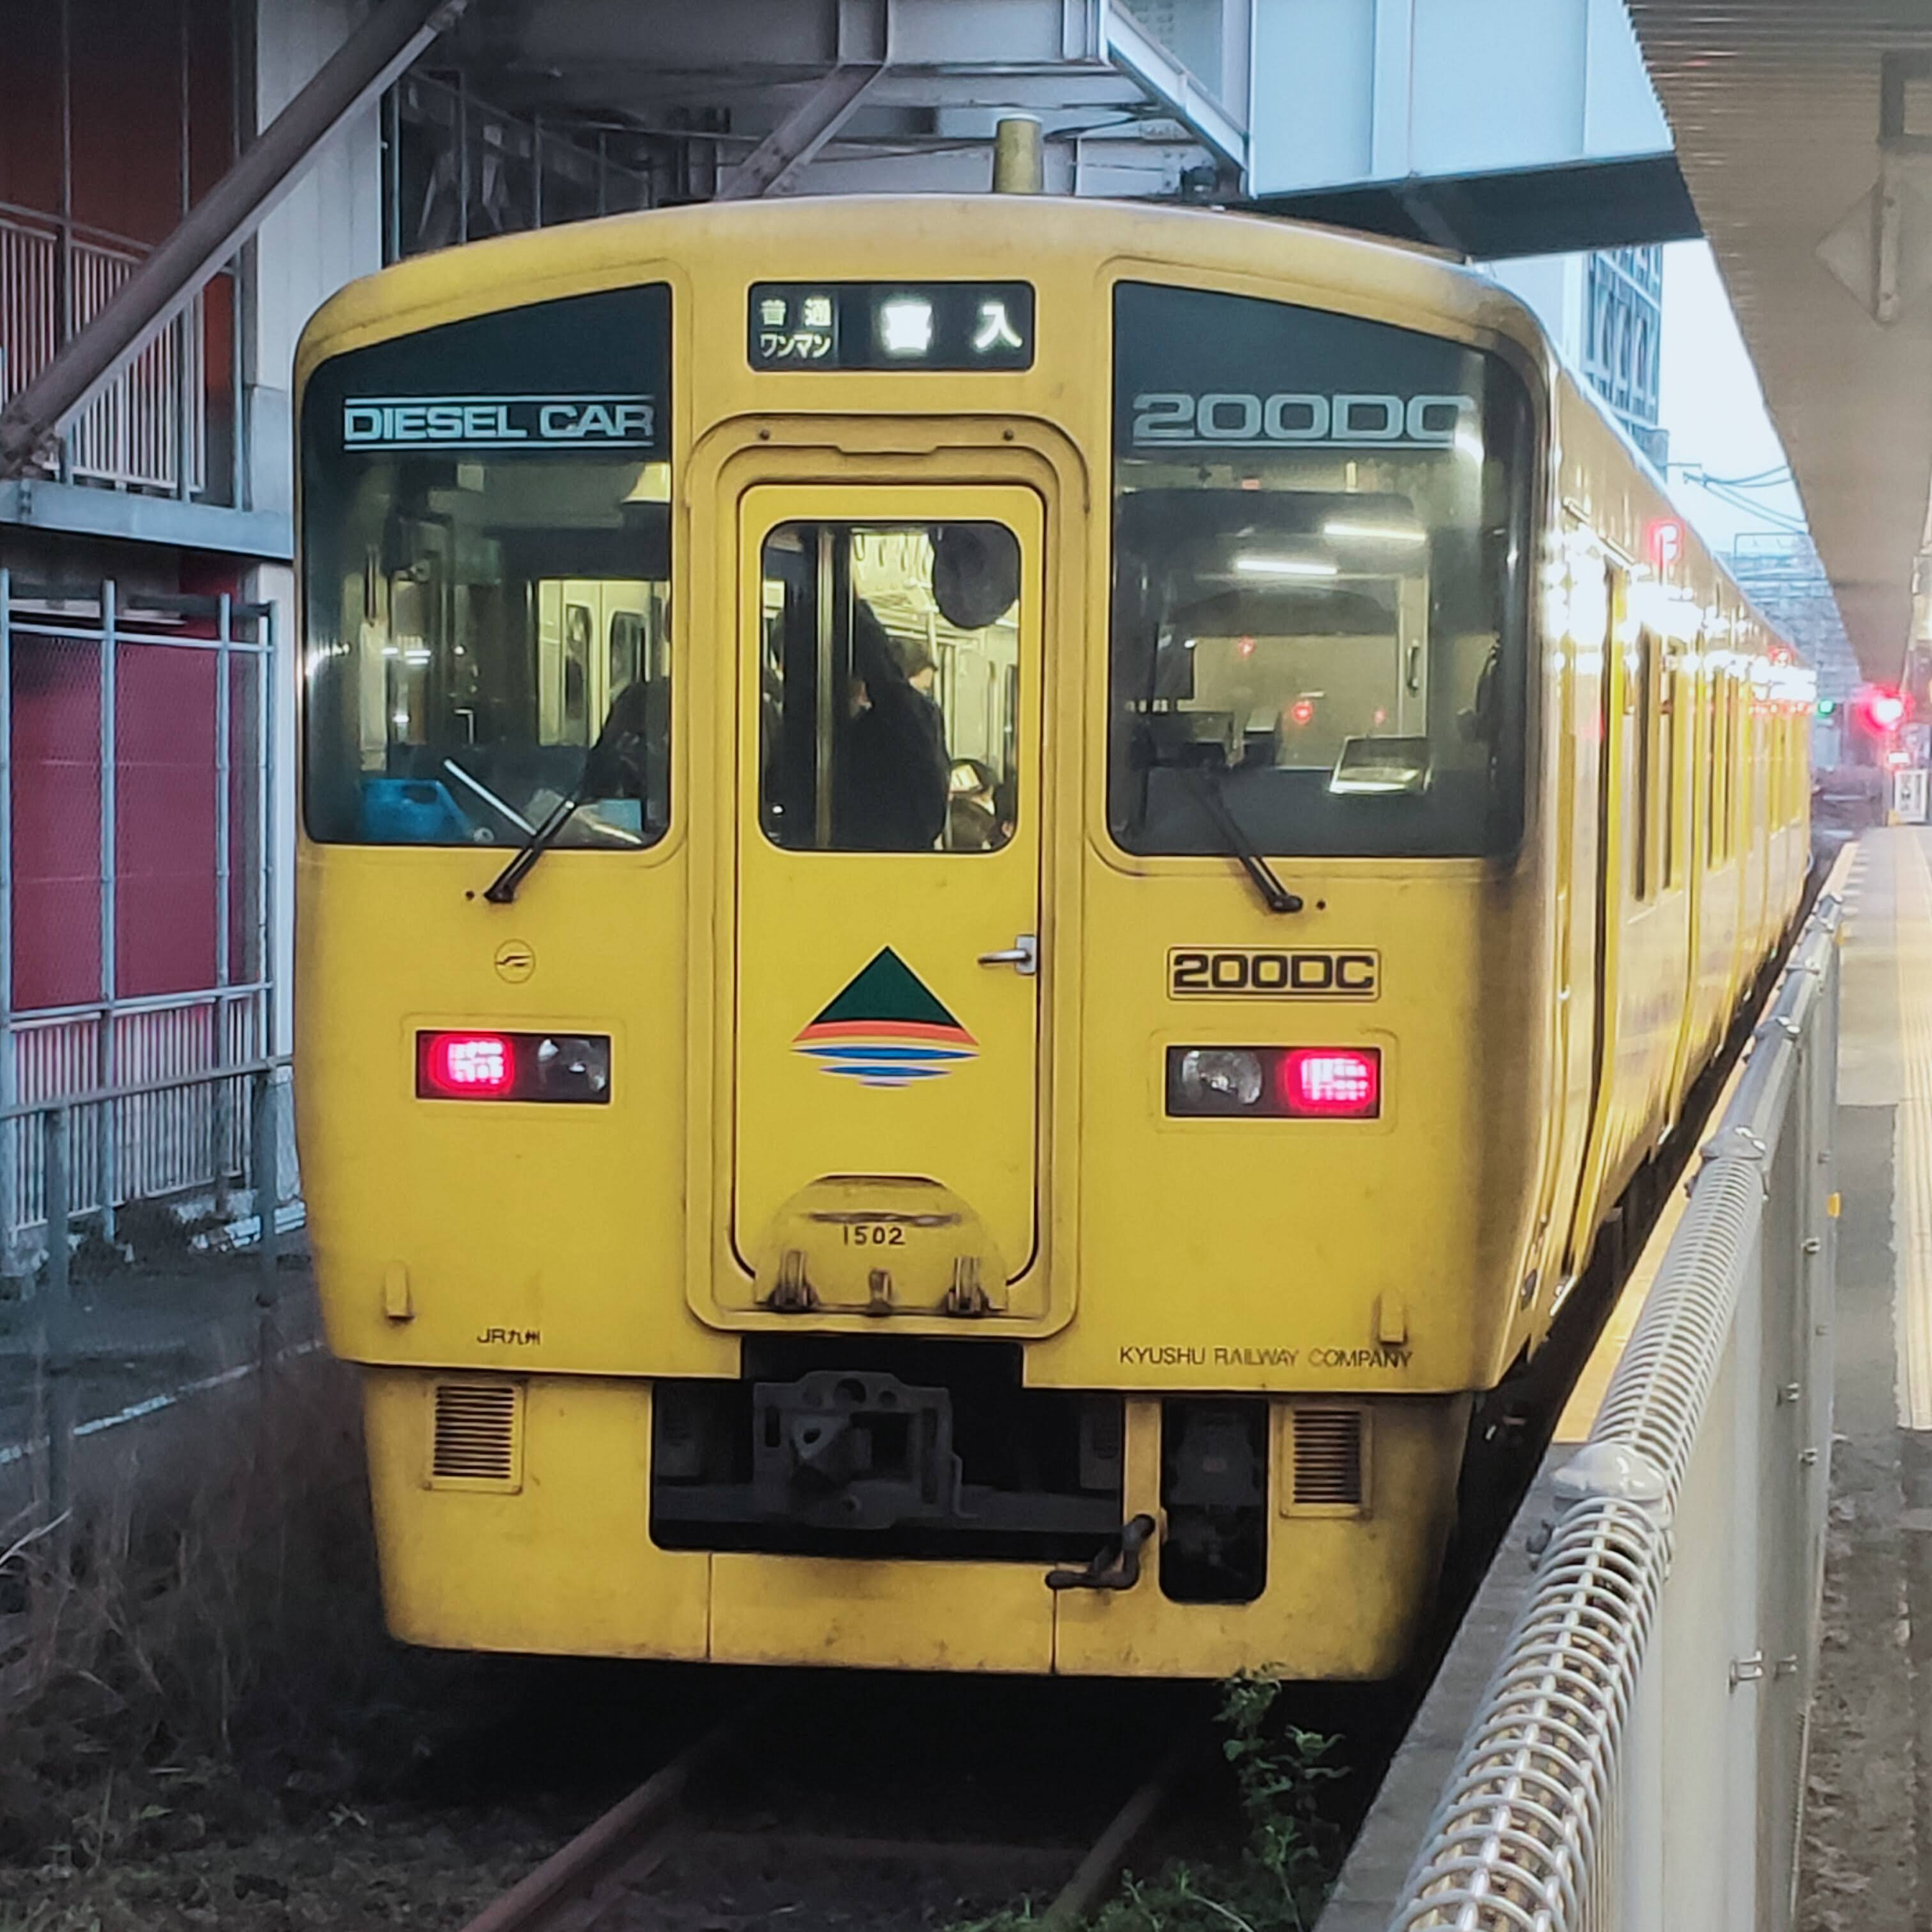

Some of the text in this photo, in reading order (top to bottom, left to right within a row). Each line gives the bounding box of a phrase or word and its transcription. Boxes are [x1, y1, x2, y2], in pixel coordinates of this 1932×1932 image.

[760, 298, 832, 327] 普通
[760, 334, 832, 359] ワンマン
[344, 404, 654, 441] DIESEL CAR
[1133, 393, 1476, 440] 200DC
[1173, 954, 1374, 989] 200DC
[843, 1225, 906, 1246] 1502
[477, 1328, 541, 1346] JR九州
[1119, 1347, 1414, 1368] KYUSHU RAILWAY COMPANY
